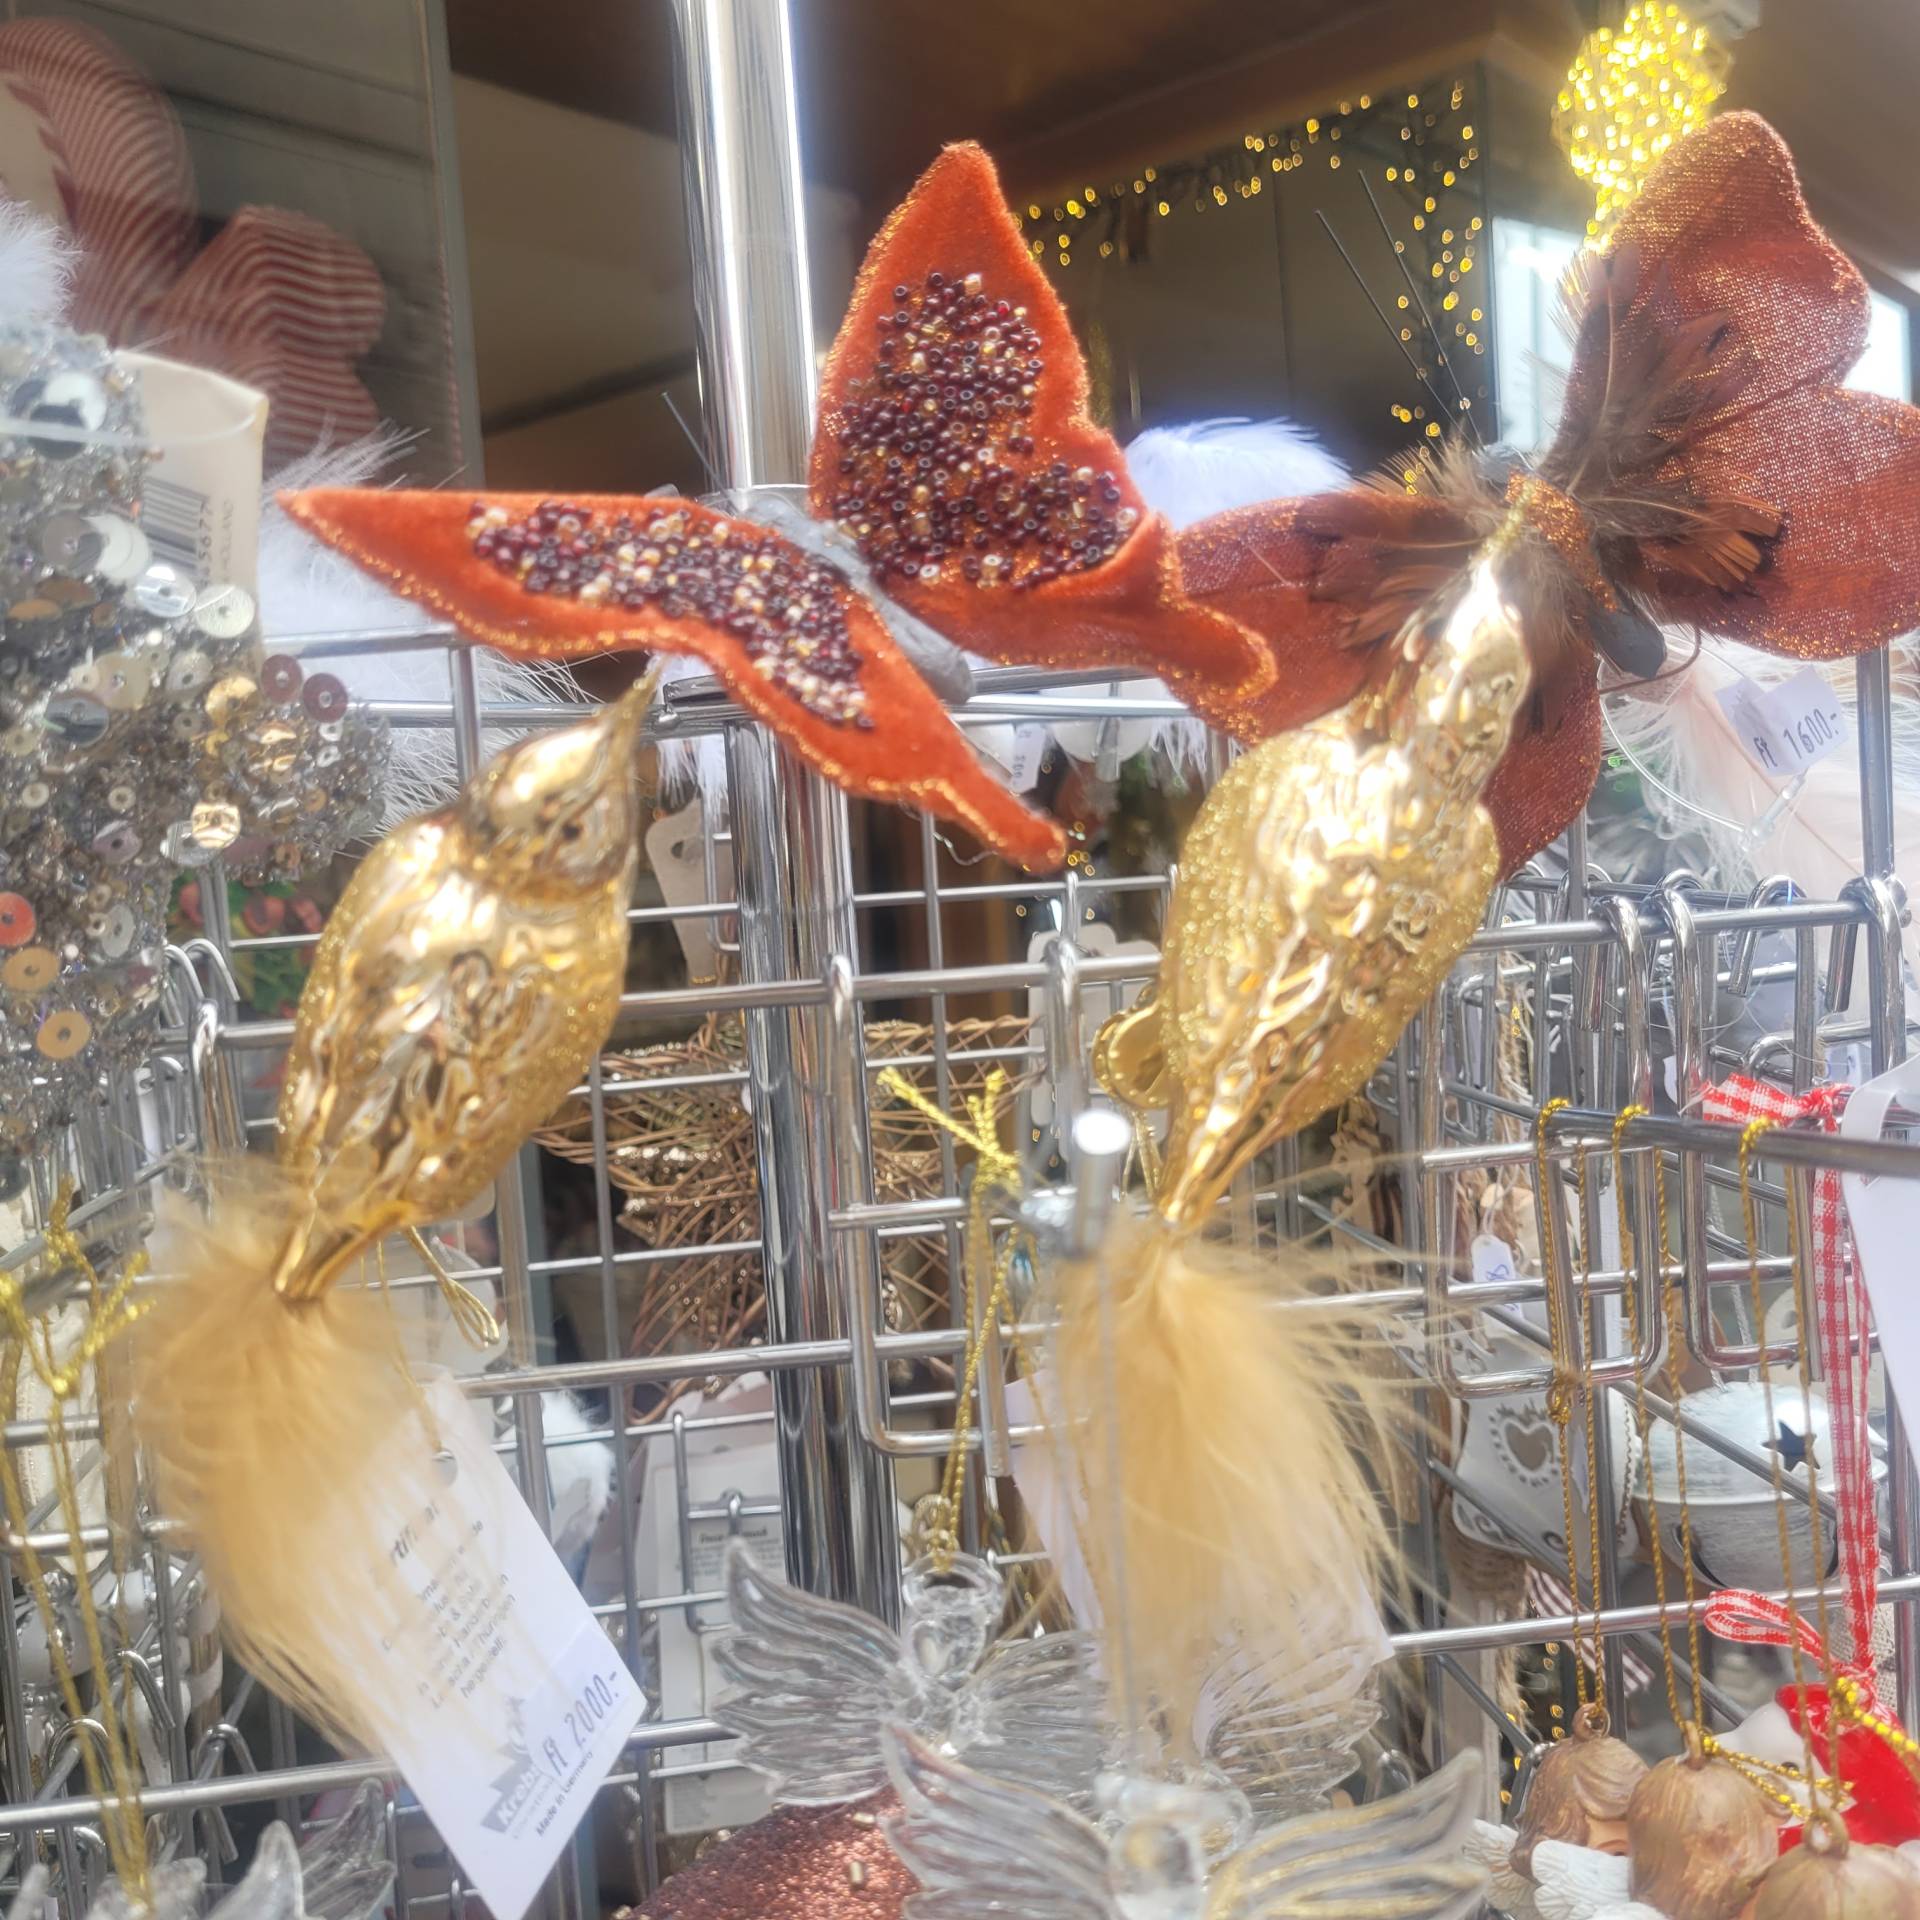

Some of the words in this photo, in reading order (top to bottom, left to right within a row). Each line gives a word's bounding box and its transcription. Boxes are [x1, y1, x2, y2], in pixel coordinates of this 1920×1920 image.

[564, 1671, 619, 1748] 2000.-
[536, 1805, 558, 1836] Made
[555, 1793, 566, 1807] in
